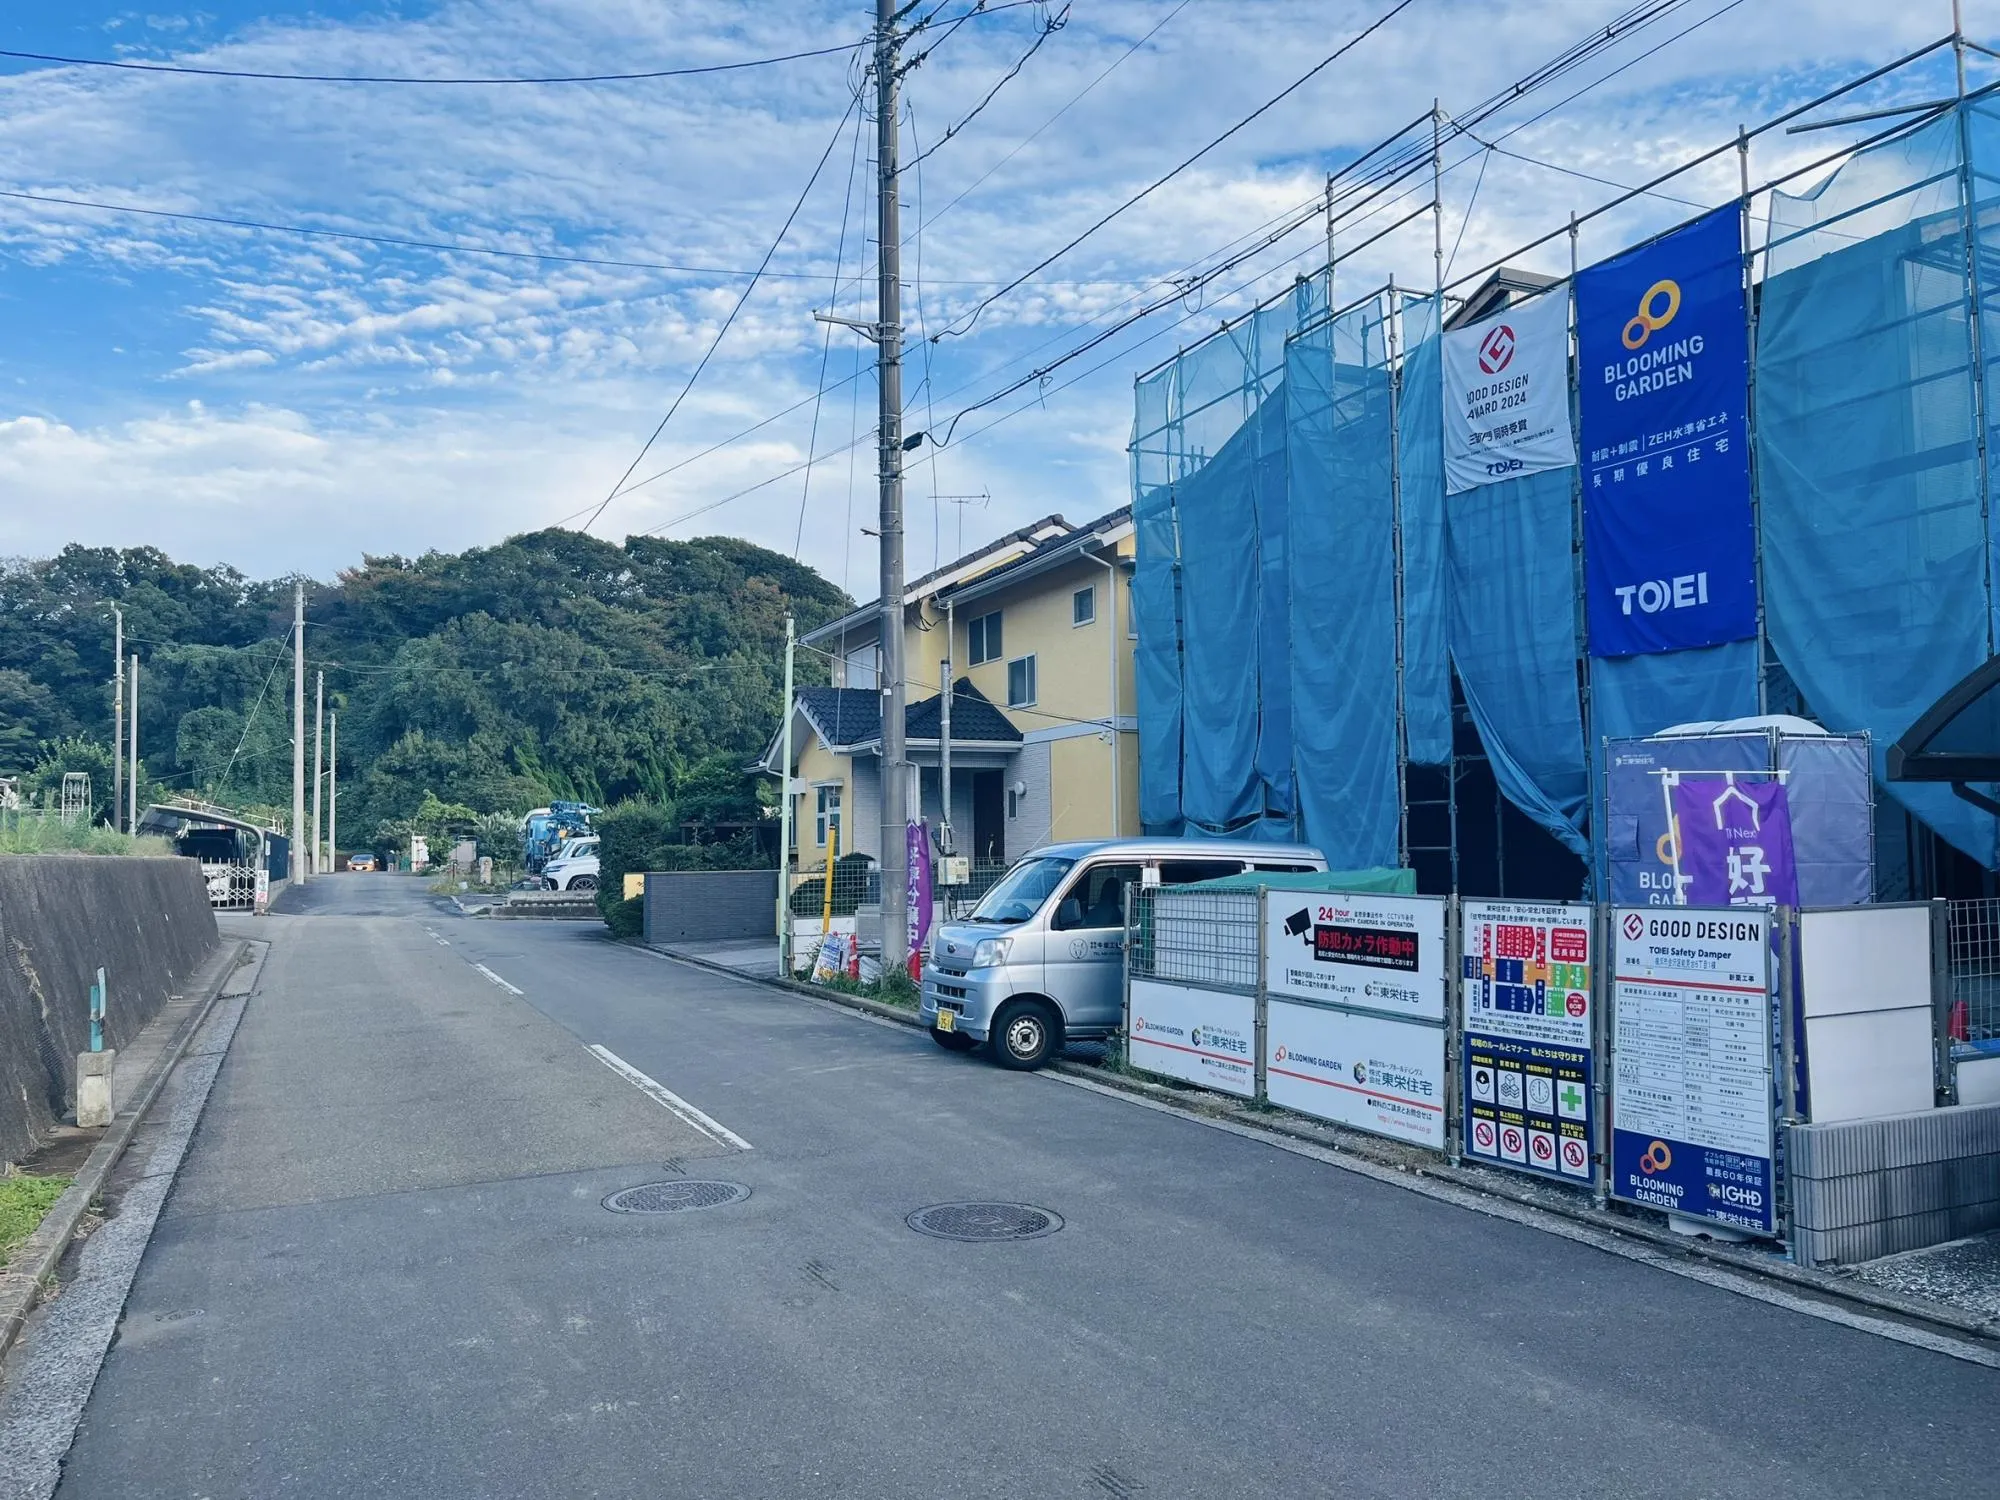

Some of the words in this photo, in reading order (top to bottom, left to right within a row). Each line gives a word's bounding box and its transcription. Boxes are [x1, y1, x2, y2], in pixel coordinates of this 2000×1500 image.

[1604, 335, 1704, 384] BLOOMING
[1491, 373, 1529, 396] DESIGN
[1615, 361, 1693, 401] GARDEN
[1501, 391, 1527, 410] 2024
[1318, 906, 1334, 921] 24
[1335, 908, 1351, 917] hour
[1387, 921, 1415, 929] OPERATION
[1650, 919, 1692, 938] GOOD
[1696, 921, 1760, 942] DESIGN
[1317, 929, 1415, 957] 防犯カメラ作動中
[1670, 948, 1696, 960] Safety
[1698, 949, 1732, 961] Damper
[1380, 987, 1420, 1003] 東栄住宅
[1211, 1035, 1247, 1054] 東栄住宅
[1470, 1038, 1530, 1053] 現場のルールとマナー
[1530, 1047, 1586, 1063] 私たちは守ります
[1288, 1051, 1317, 1067] BLOOMING
[1317, 1058, 1343, 1072] GARDEN
[1381, 1072, 1433, 1097] 東栄住宅
[1630, 1174, 1684, 1197] BLOOMING
[1705, 1166, 1763, 1187] 最長60年保証
[1636, 1188, 1679, 1209] GARDEN
[1715, 1210, 1763, 1231] 東栄住宅
